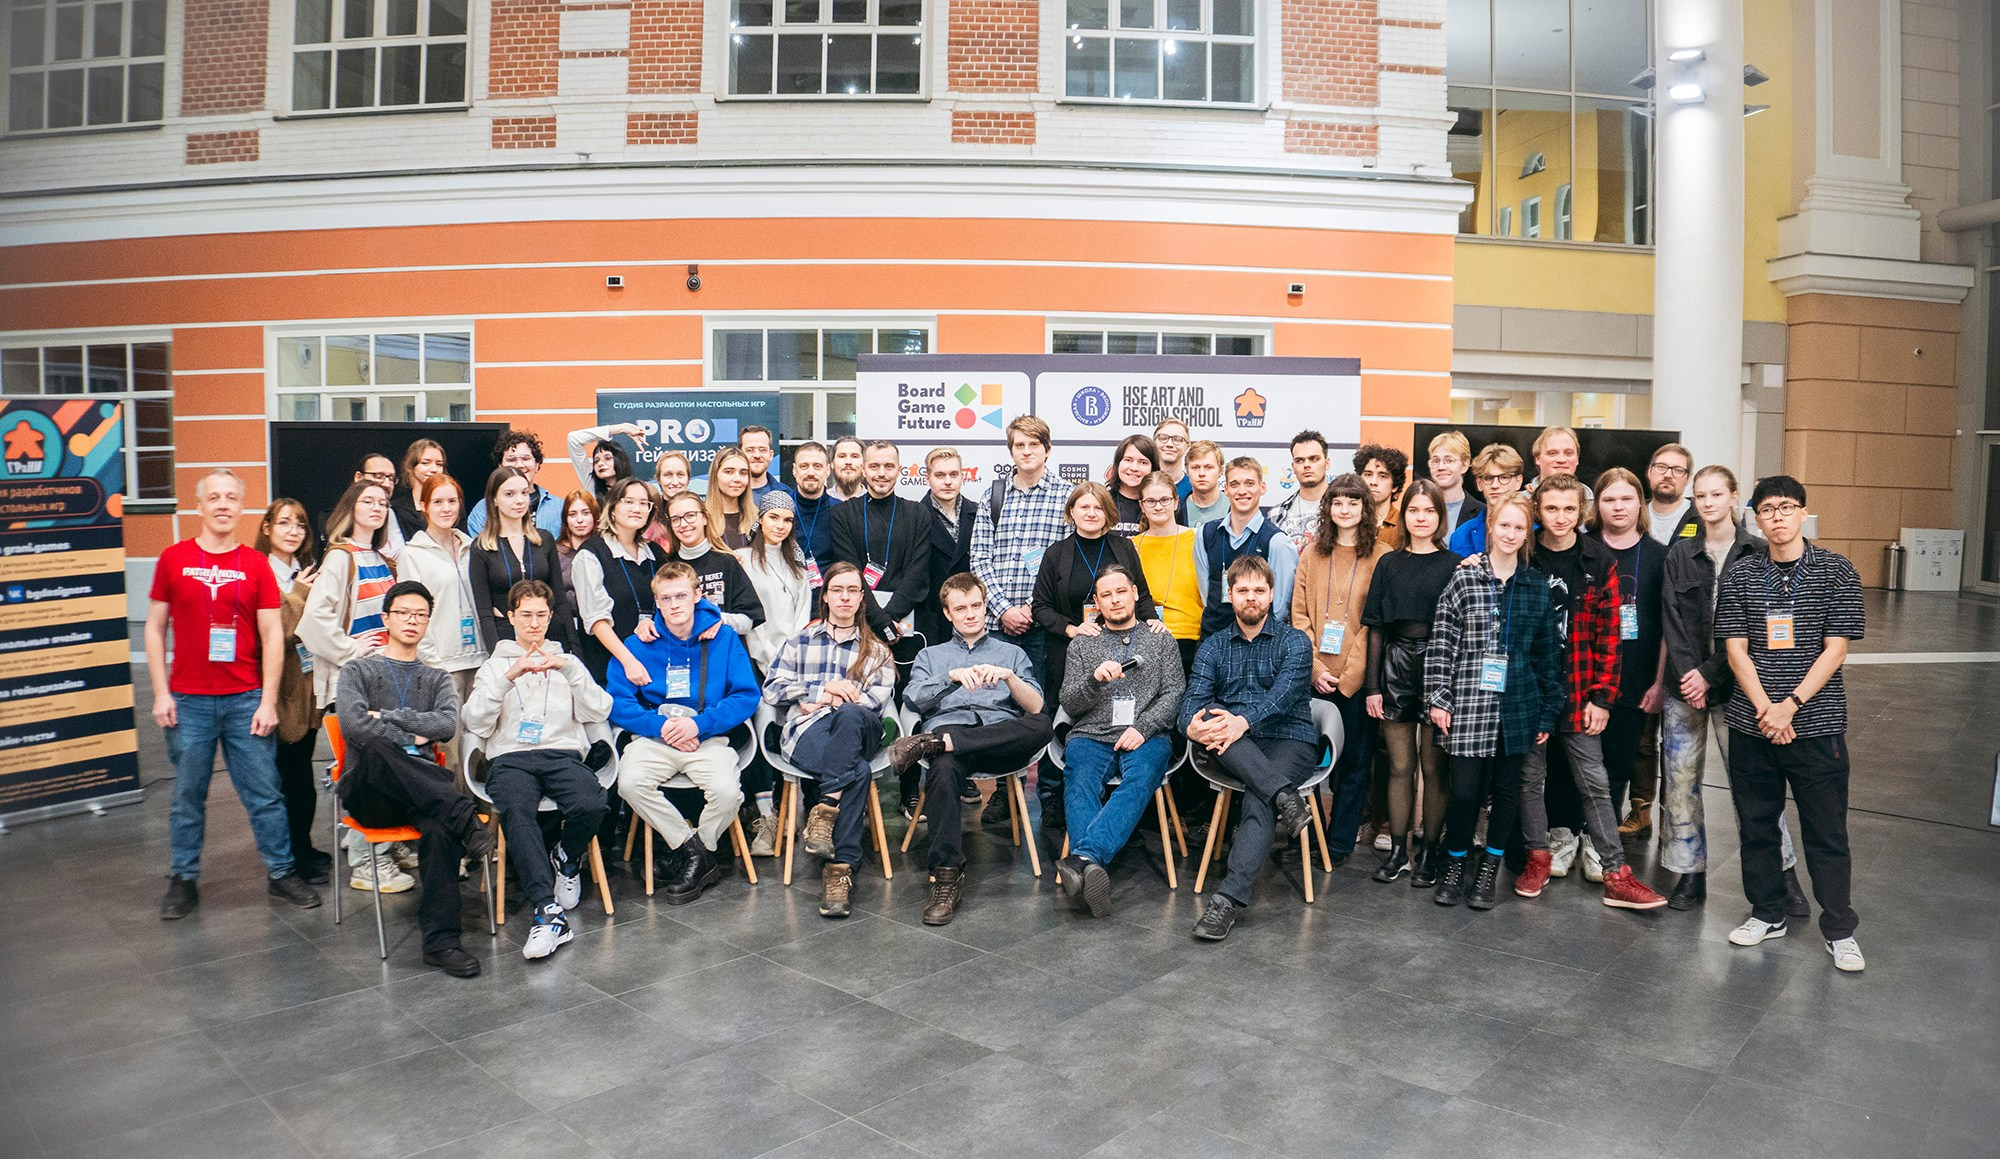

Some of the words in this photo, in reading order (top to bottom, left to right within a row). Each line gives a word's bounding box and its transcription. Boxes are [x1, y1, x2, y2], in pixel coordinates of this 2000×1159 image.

[898, 382, 946, 398] Board
[1122, 386, 1148, 406] HSE
[1150, 386, 1176, 407] ART
[1178, 387, 1204, 407] AND
[645, 401, 695, 409] РАЗРАБОТКИ
[898, 399, 946, 413] Game
[898, 415, 951, 429] Future
[637, 418, 710, 443] PRO
[3, 542, 71, 556] grani.games
